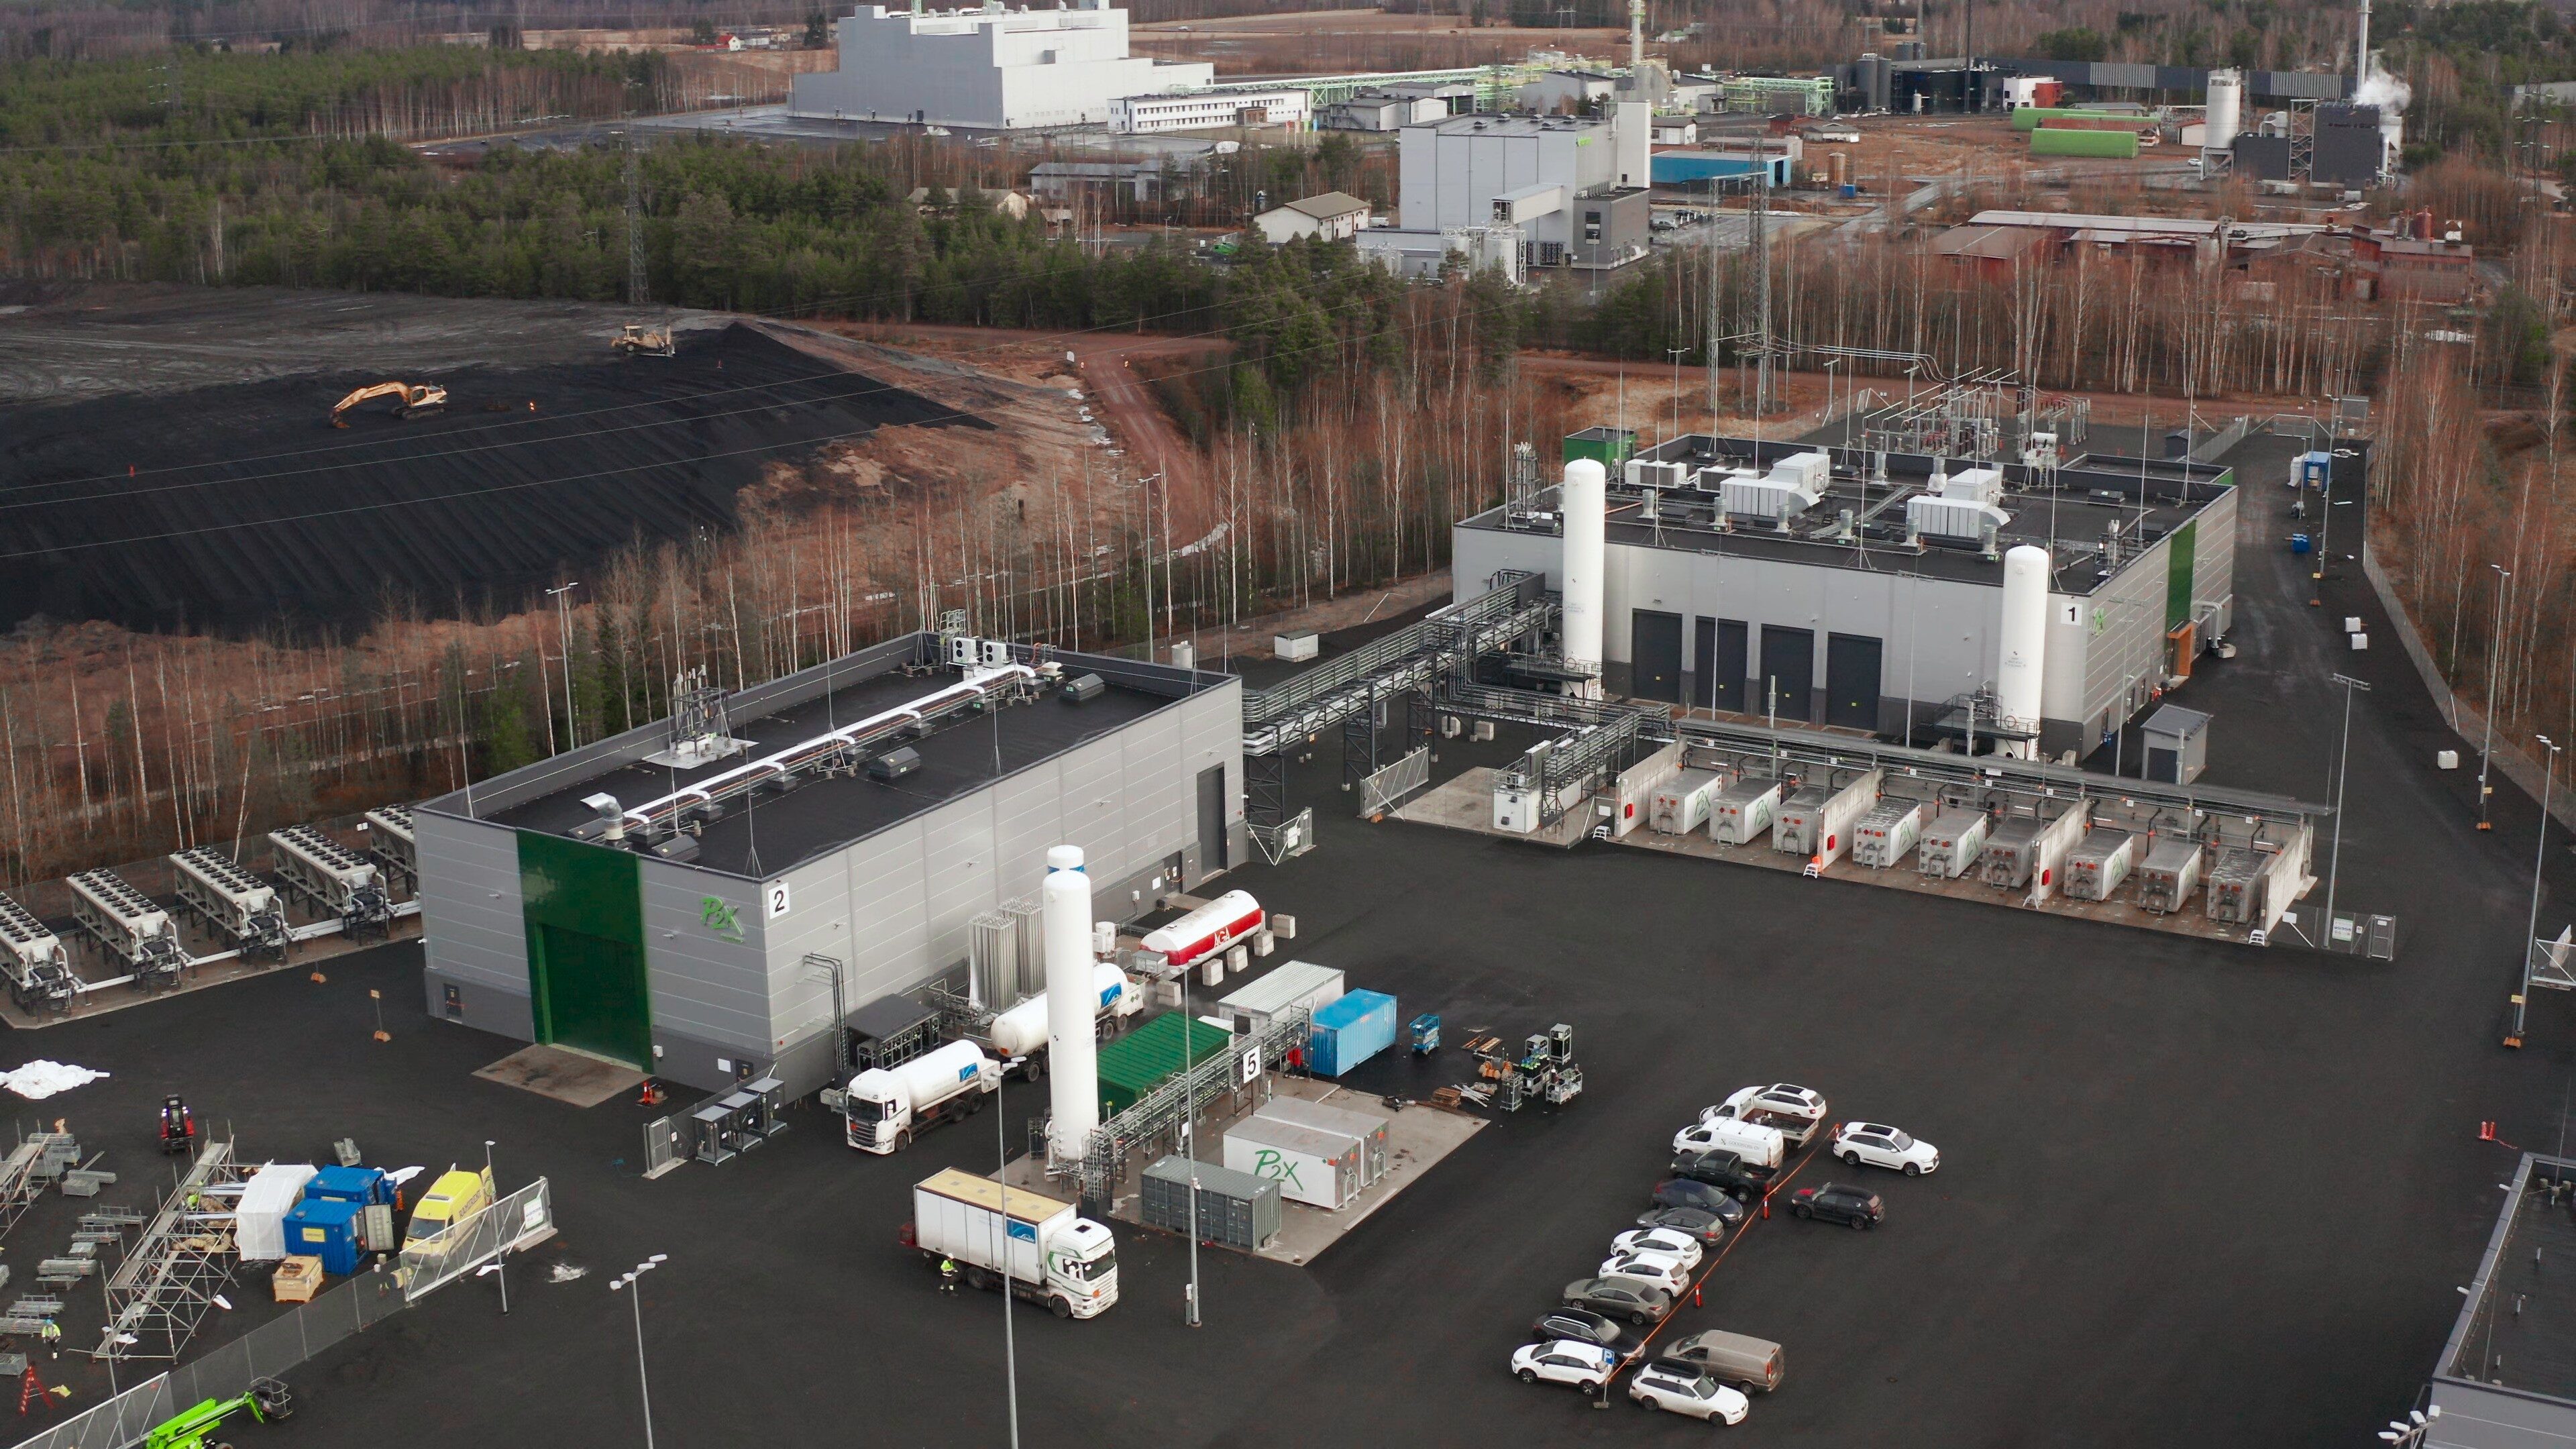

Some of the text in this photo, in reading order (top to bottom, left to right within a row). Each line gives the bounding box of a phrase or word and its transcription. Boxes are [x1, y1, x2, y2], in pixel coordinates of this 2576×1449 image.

[2068, 606, 2075, 621] 1
[774, 890, 785, 913] 2
[700, 897, 744, 936] P2X
[1214, 926, 1230, 949] AGA
[1248, 1052, 1256, 1075] 5
[1254, 1149, 1303, 1192] P2X
[1603, 1349, 1613, 1362] P
